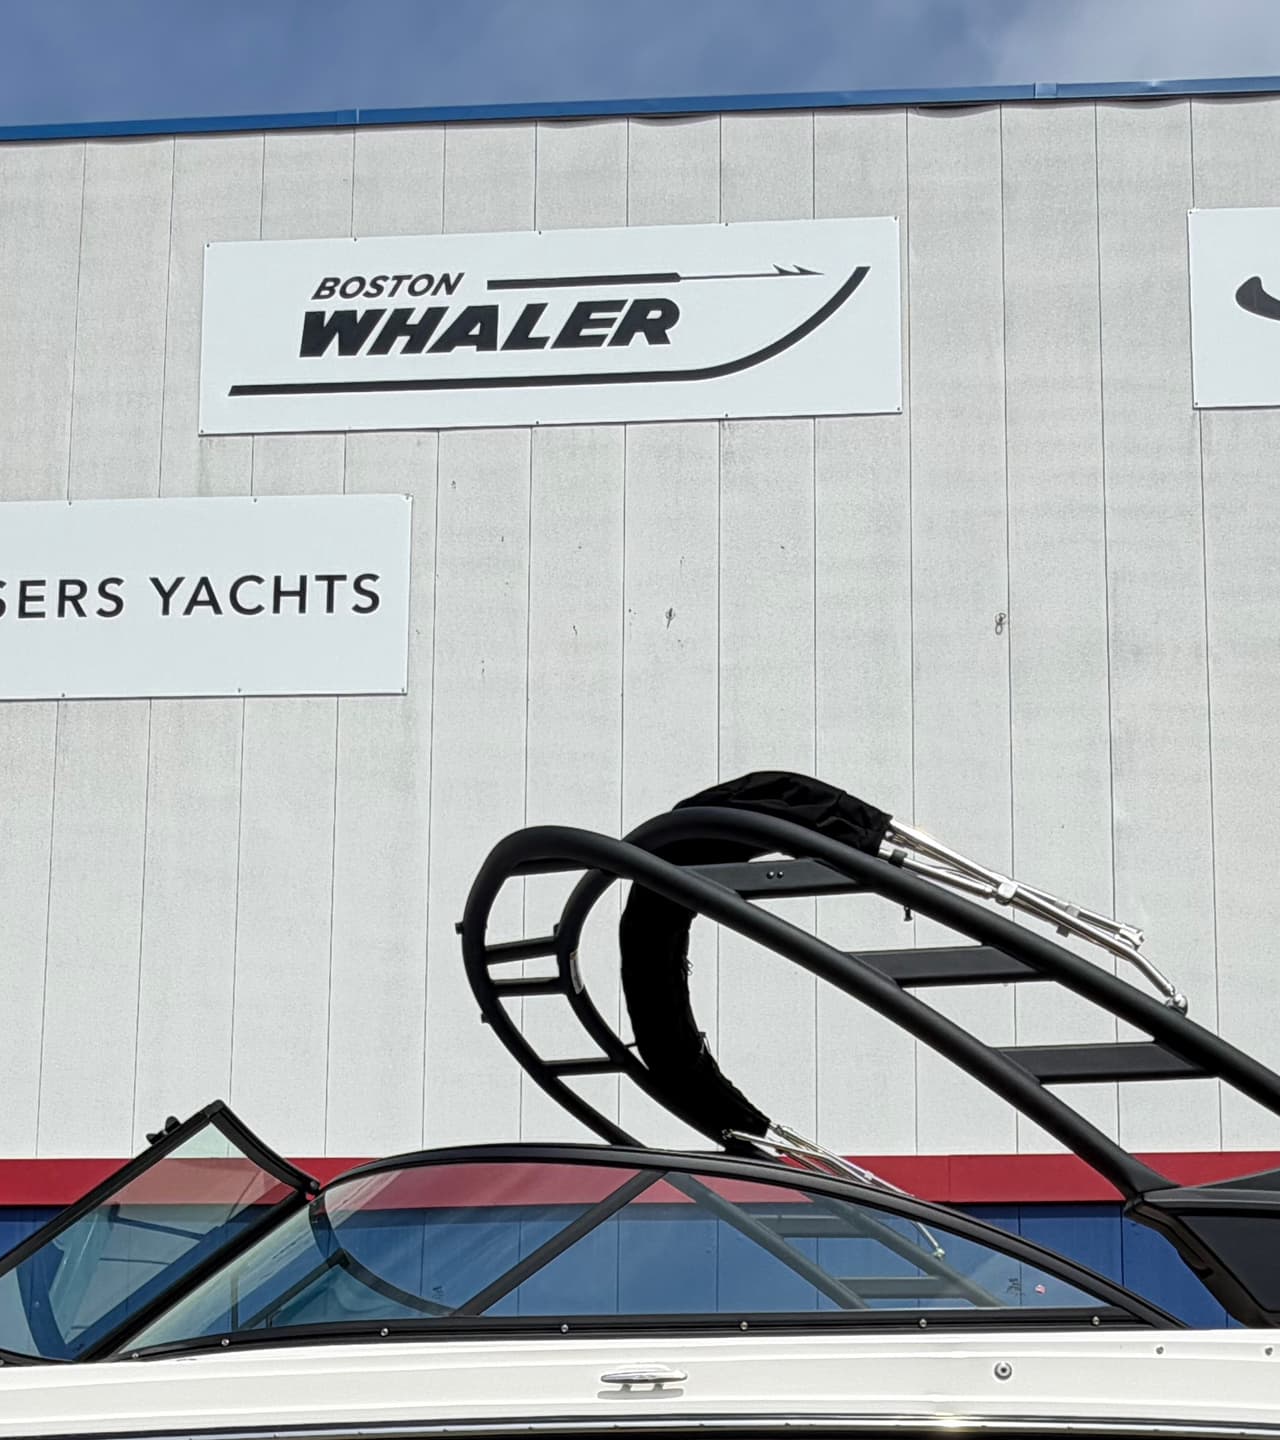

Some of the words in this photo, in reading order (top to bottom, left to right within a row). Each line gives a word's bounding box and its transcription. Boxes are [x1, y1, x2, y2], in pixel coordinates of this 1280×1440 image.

[311, 272, 465, 300] BOSTON
[299, 298, 680, 358] WHALER
[149, 573, 380, 616] YACHTS
